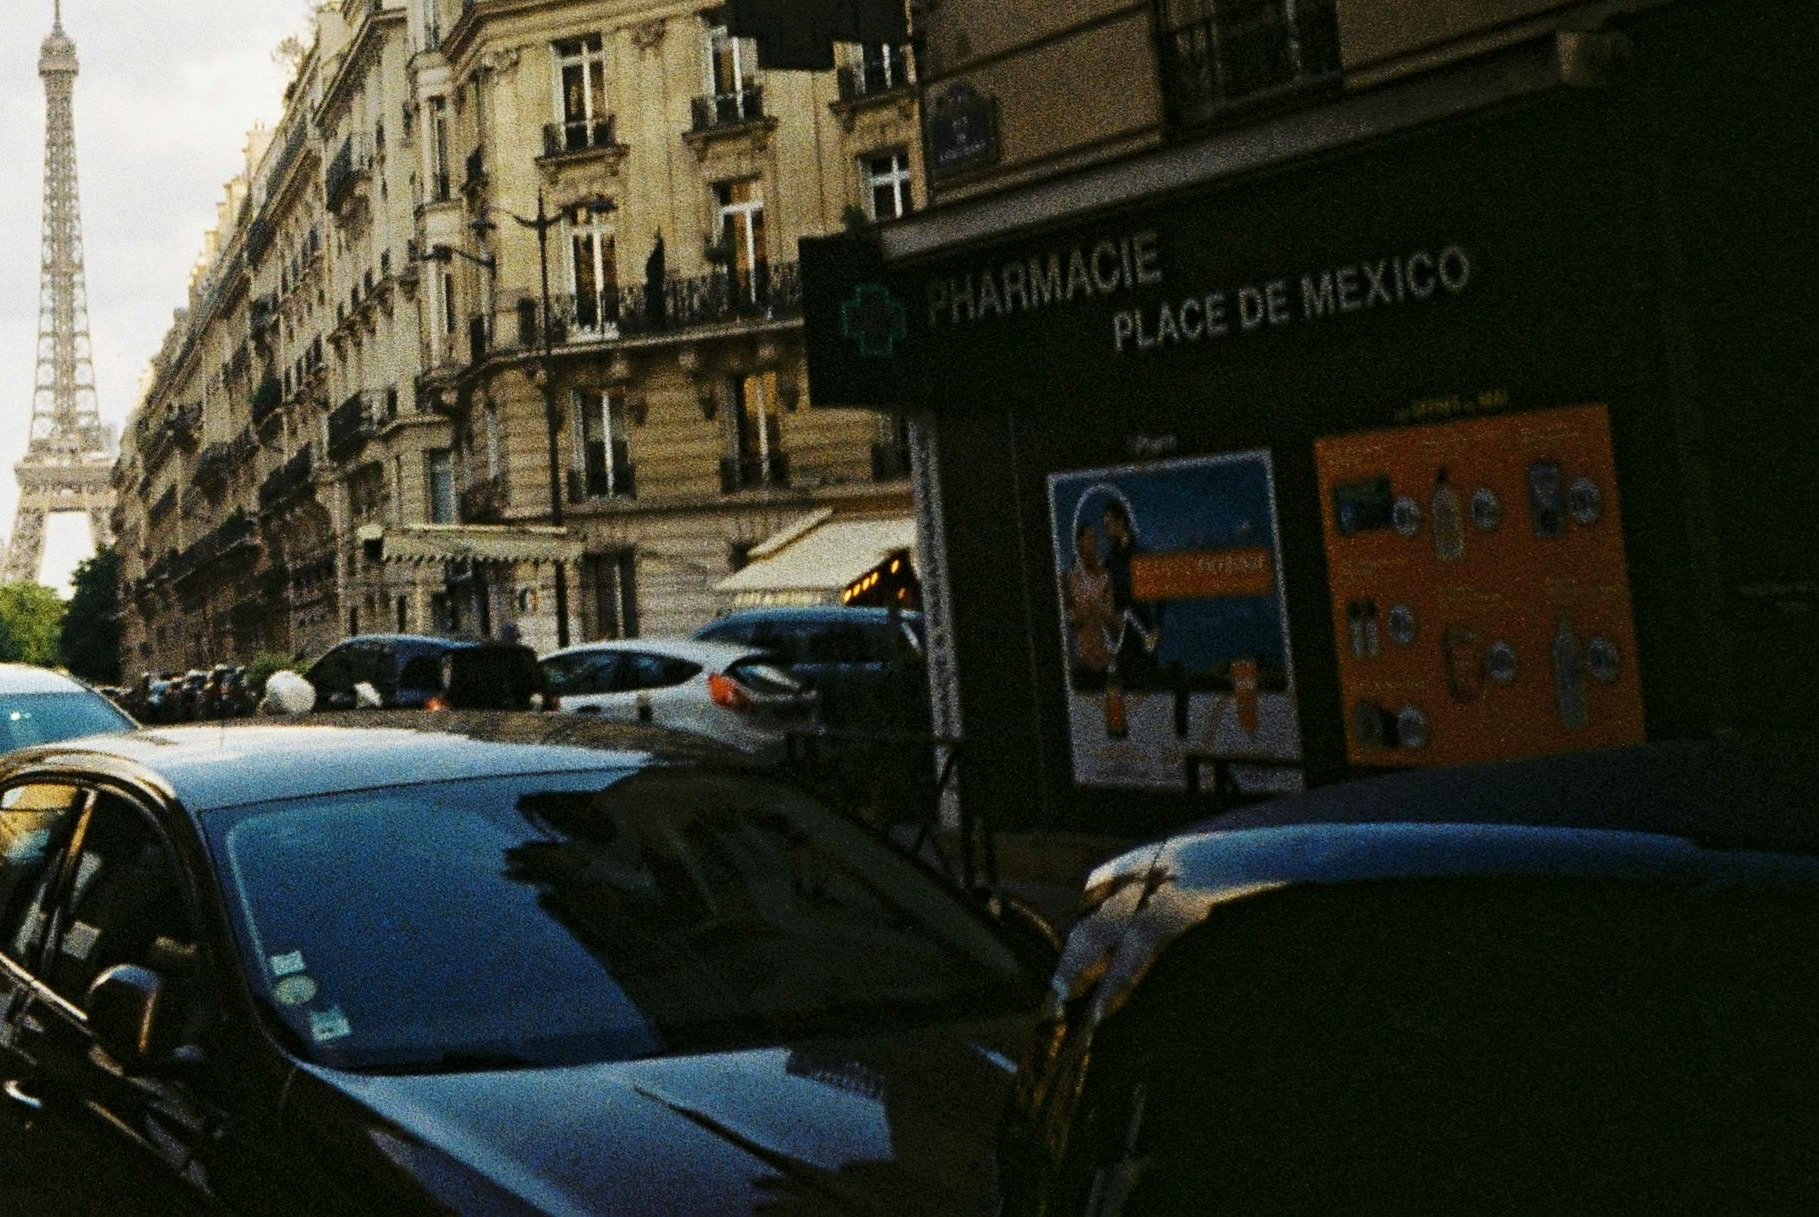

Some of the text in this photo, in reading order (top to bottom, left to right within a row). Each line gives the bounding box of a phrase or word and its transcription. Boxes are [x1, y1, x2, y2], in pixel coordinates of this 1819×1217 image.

[926, 232, 1163, 326] PHARMACIE
[1112, 245, 1471, 352] PLACE DE MEXICO
